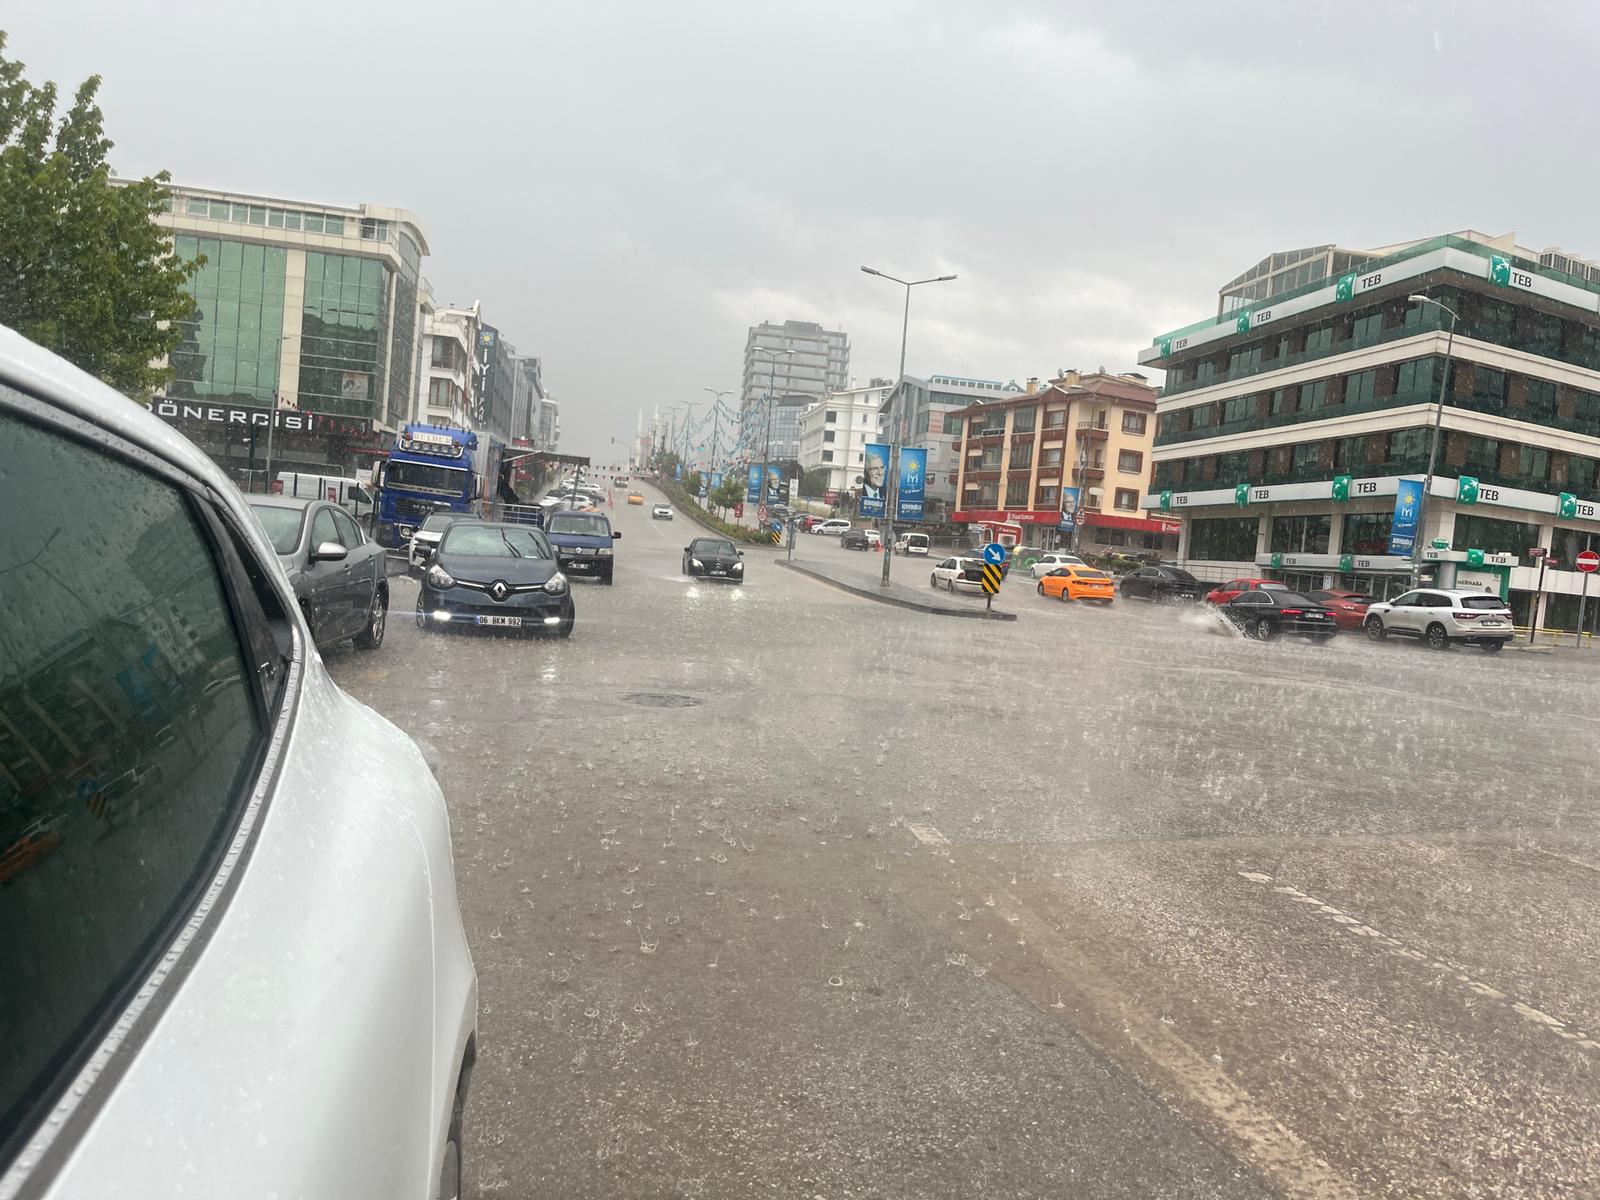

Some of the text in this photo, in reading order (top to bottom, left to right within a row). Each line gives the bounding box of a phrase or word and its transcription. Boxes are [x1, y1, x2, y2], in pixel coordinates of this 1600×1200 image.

[1362, 273, 1382, 289] TEB
[1512, 272, 1532, 288] TEB
[1256, 310, 1272, 323] TEB
[1175, 339, 1188, 350] TEB
[1357, 482, 1377, 493] TEB
[1175, 495, 1188, 505] TEB
[1254, 489, 1270, 500] TEB
[1480, 488, 1499, 501] TEB
[1577, 504, 1594, 516] TEB
[1427, 551, 1439, 559] TEB
[1491, 556, 1506, 564] TEB
[1286, 557, 1297, 565] TEB
[1357, 560, 1370, 568] TEB
[480, 615, 488, 624] 06
[508, 617, 521, 626] 992
